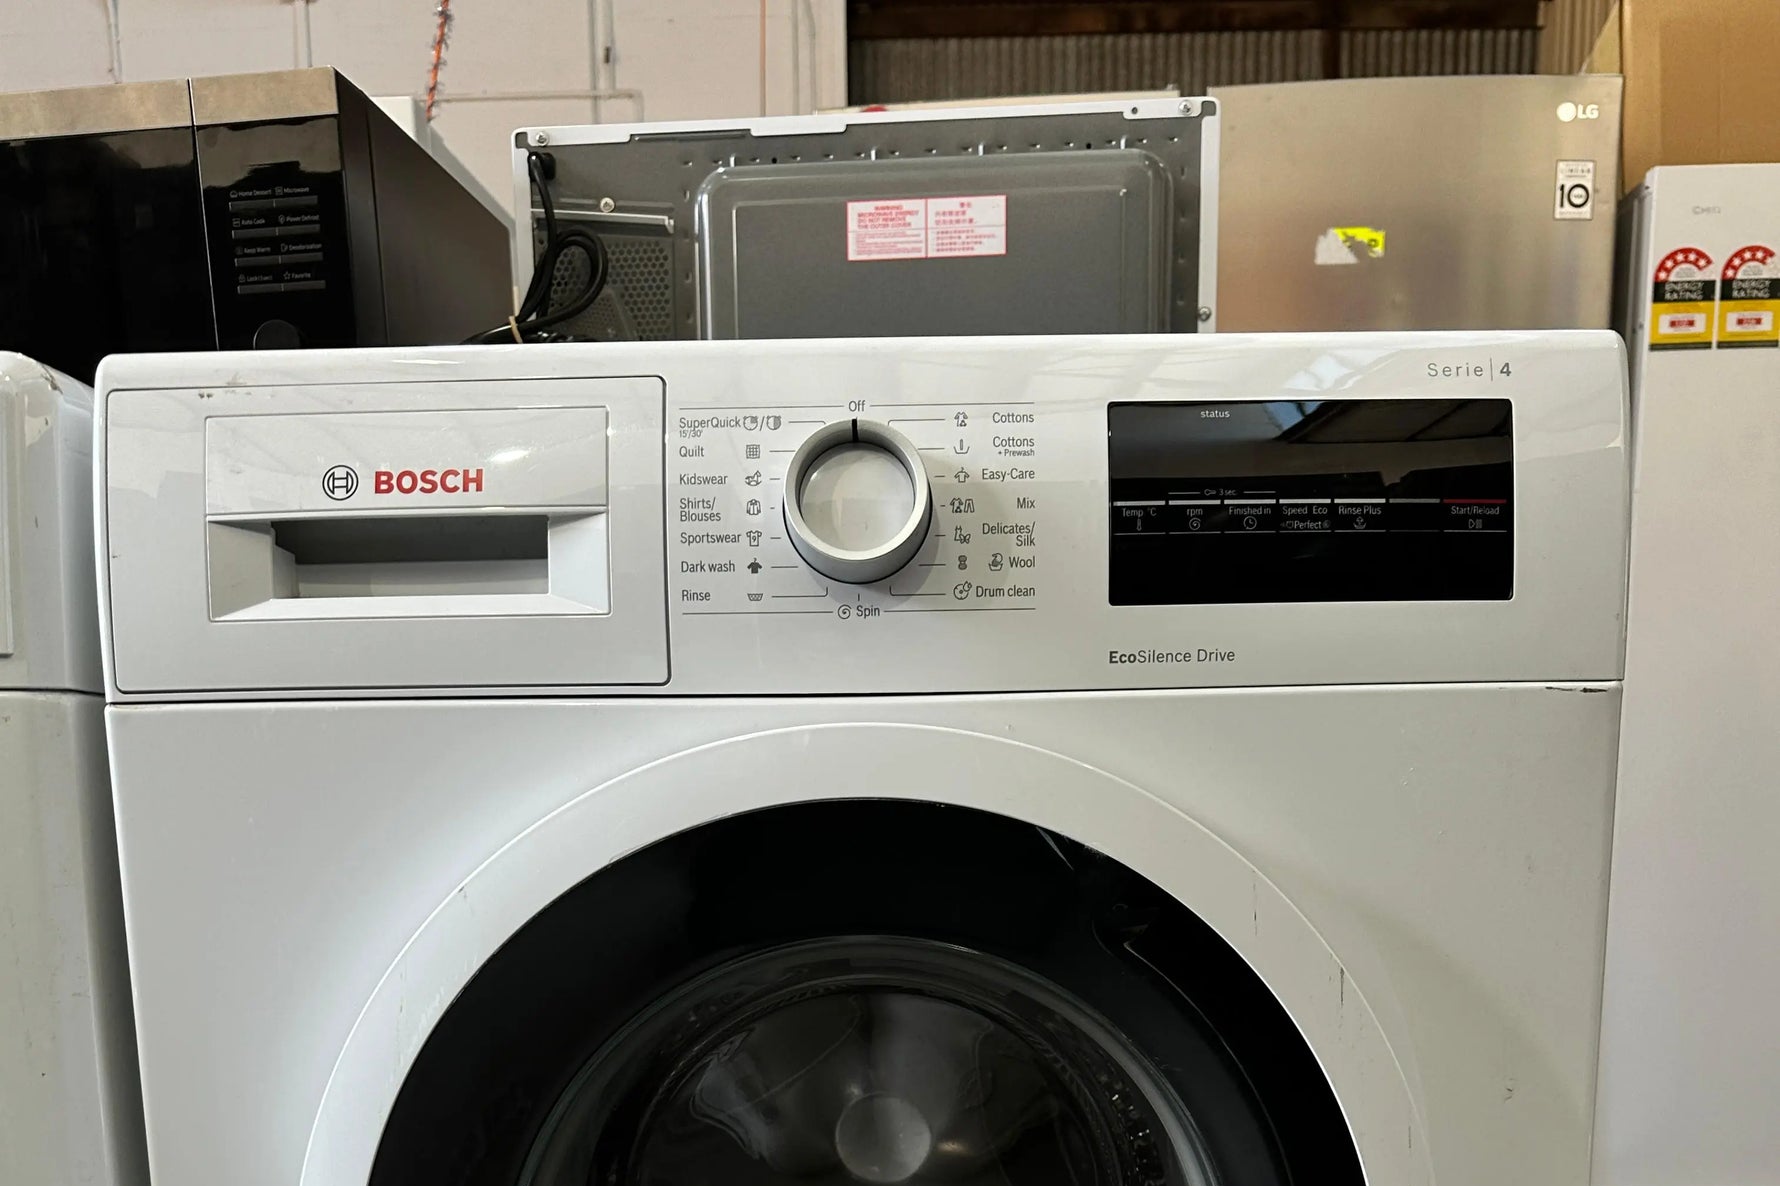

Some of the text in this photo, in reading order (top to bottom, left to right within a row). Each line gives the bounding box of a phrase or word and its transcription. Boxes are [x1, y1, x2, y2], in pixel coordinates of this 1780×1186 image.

[1577, 104, 1599, 119] LG
[1559, 183, 1590, 208] 10
[1664, 291, 1703, 300] RATING
[1732, 289, 1770, 298] RATING
[1427, 362, 1512, 378] Serie 4
[848, 400, 866, 412] Off
[992, 411, 1035, 424] Cottons
[1200, 408, 1230, 419] status
[679, 416, 741, 431] SuperQuick
[992, 436, 1035, 448] Cottons
[679, 445, 705, 458] Quilt
[1003, 448, 1035, 457] Prewash
[679, 473, 728, 485] Kidswear
[981, 467, 1035, 482] Easy-Care
[374, 468, 484, 494] BOSCH
[679, 497, 716, 511] Shirts/
[1016, 498, 1035, 509] Mix
[680, 510, 721, 522] Blouses
[1122, 508, 1144, 518] Temp
[1186, 508, 1203, 516] rpm
[1228, 506, 1272, 516] Finished in
[1282, 506, 1308, 516] Speed
[1312, 505, 1328, 515] Eco
[1338, 505, 1382, 515] Rinse Plus
[981, 522, 1035, 536] Delicates/
[679, 531, 742, 546] Sportswear
[1015, 534, 1036, 547] Silk
[680, 560, 736, 573] Dark wash
[1008, 556, 1036, 568] Wool
[681, 589, 711, 601] Rinse
[975, 584, 1036, 598] Drum clean
[856, 604, 881, 619] Spin
[1108, 647, 1236, 665] EcoSilence Drive
